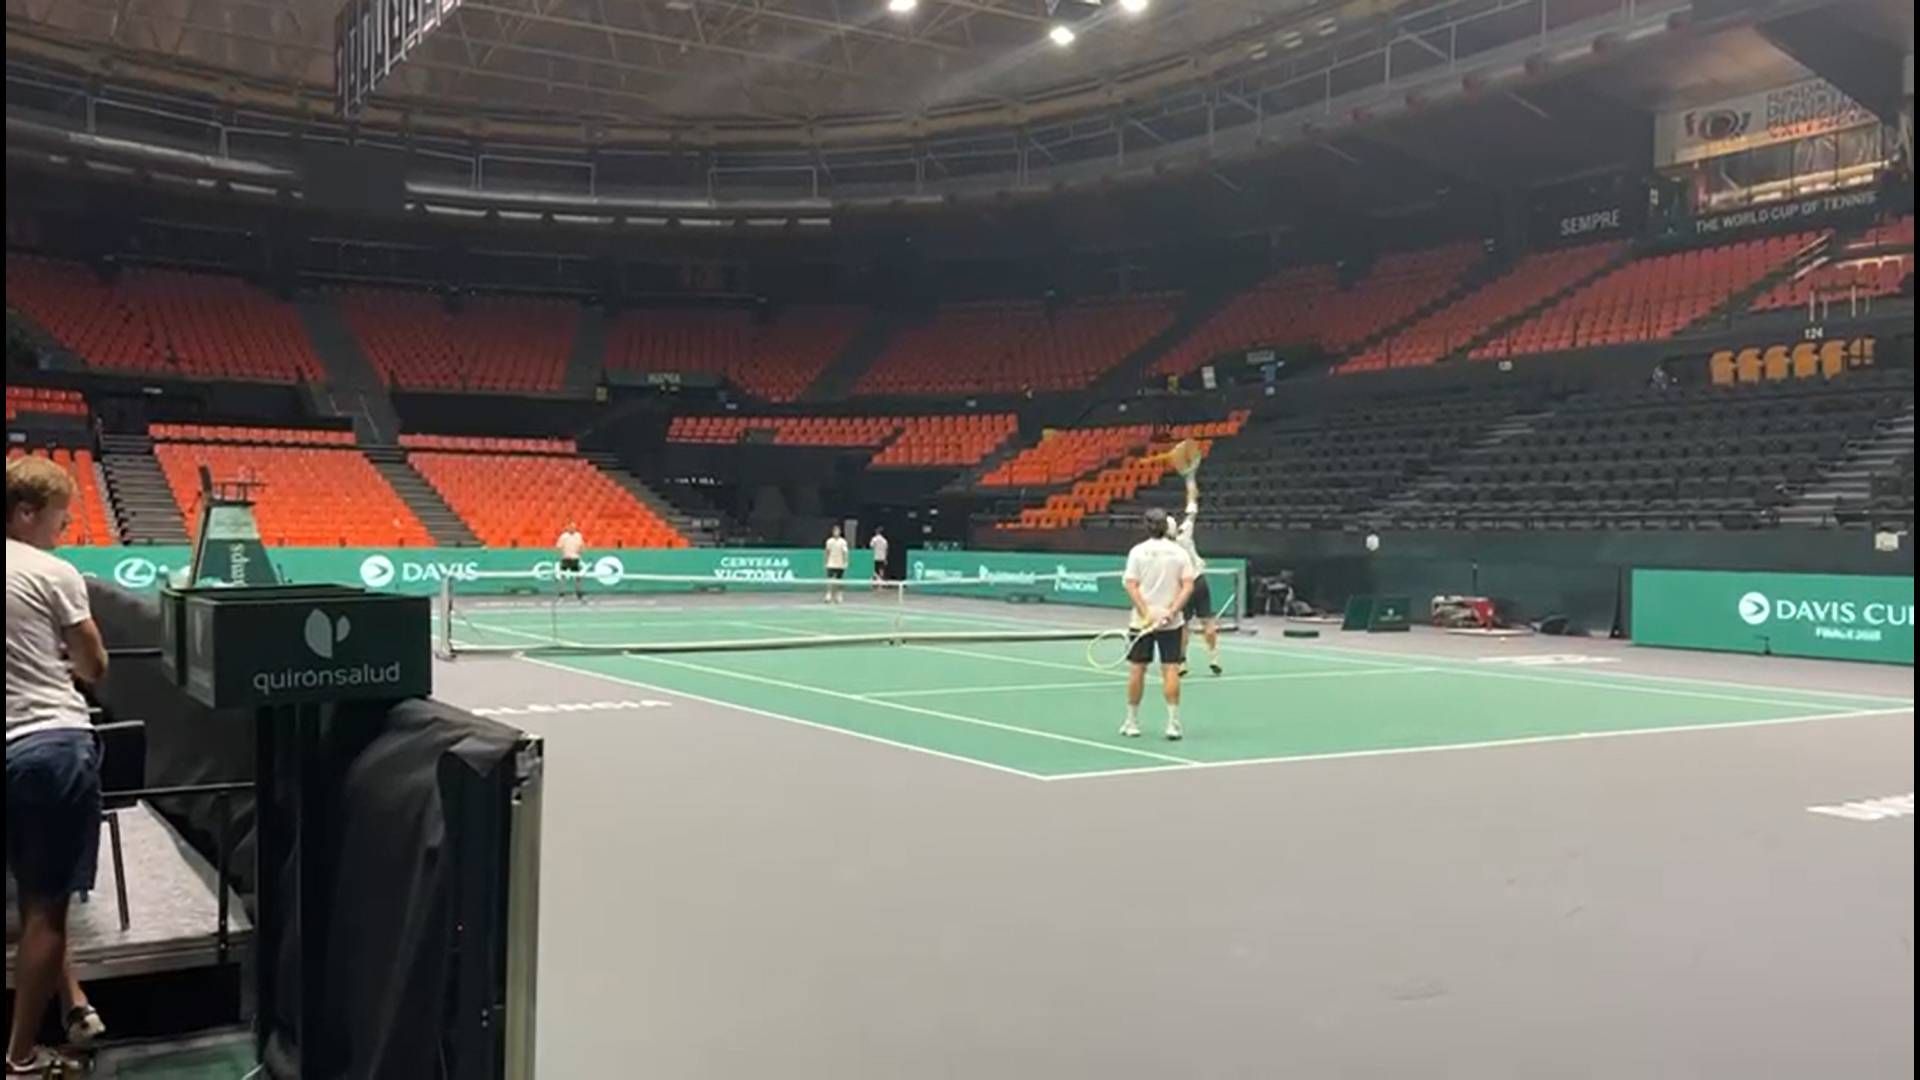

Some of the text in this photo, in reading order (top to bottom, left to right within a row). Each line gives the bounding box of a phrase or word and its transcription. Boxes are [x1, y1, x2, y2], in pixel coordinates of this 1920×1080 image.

[1561, 208, 1620, 236] SEMPRE
[1696, 190, 1877, 234] THE WORLD CUP OF TENNIS
[403, 562, 479, 581] DAVIS
[714, 569, 796, 582] VICTORIA
[1776, 599, 1856, 624] DAVIS
